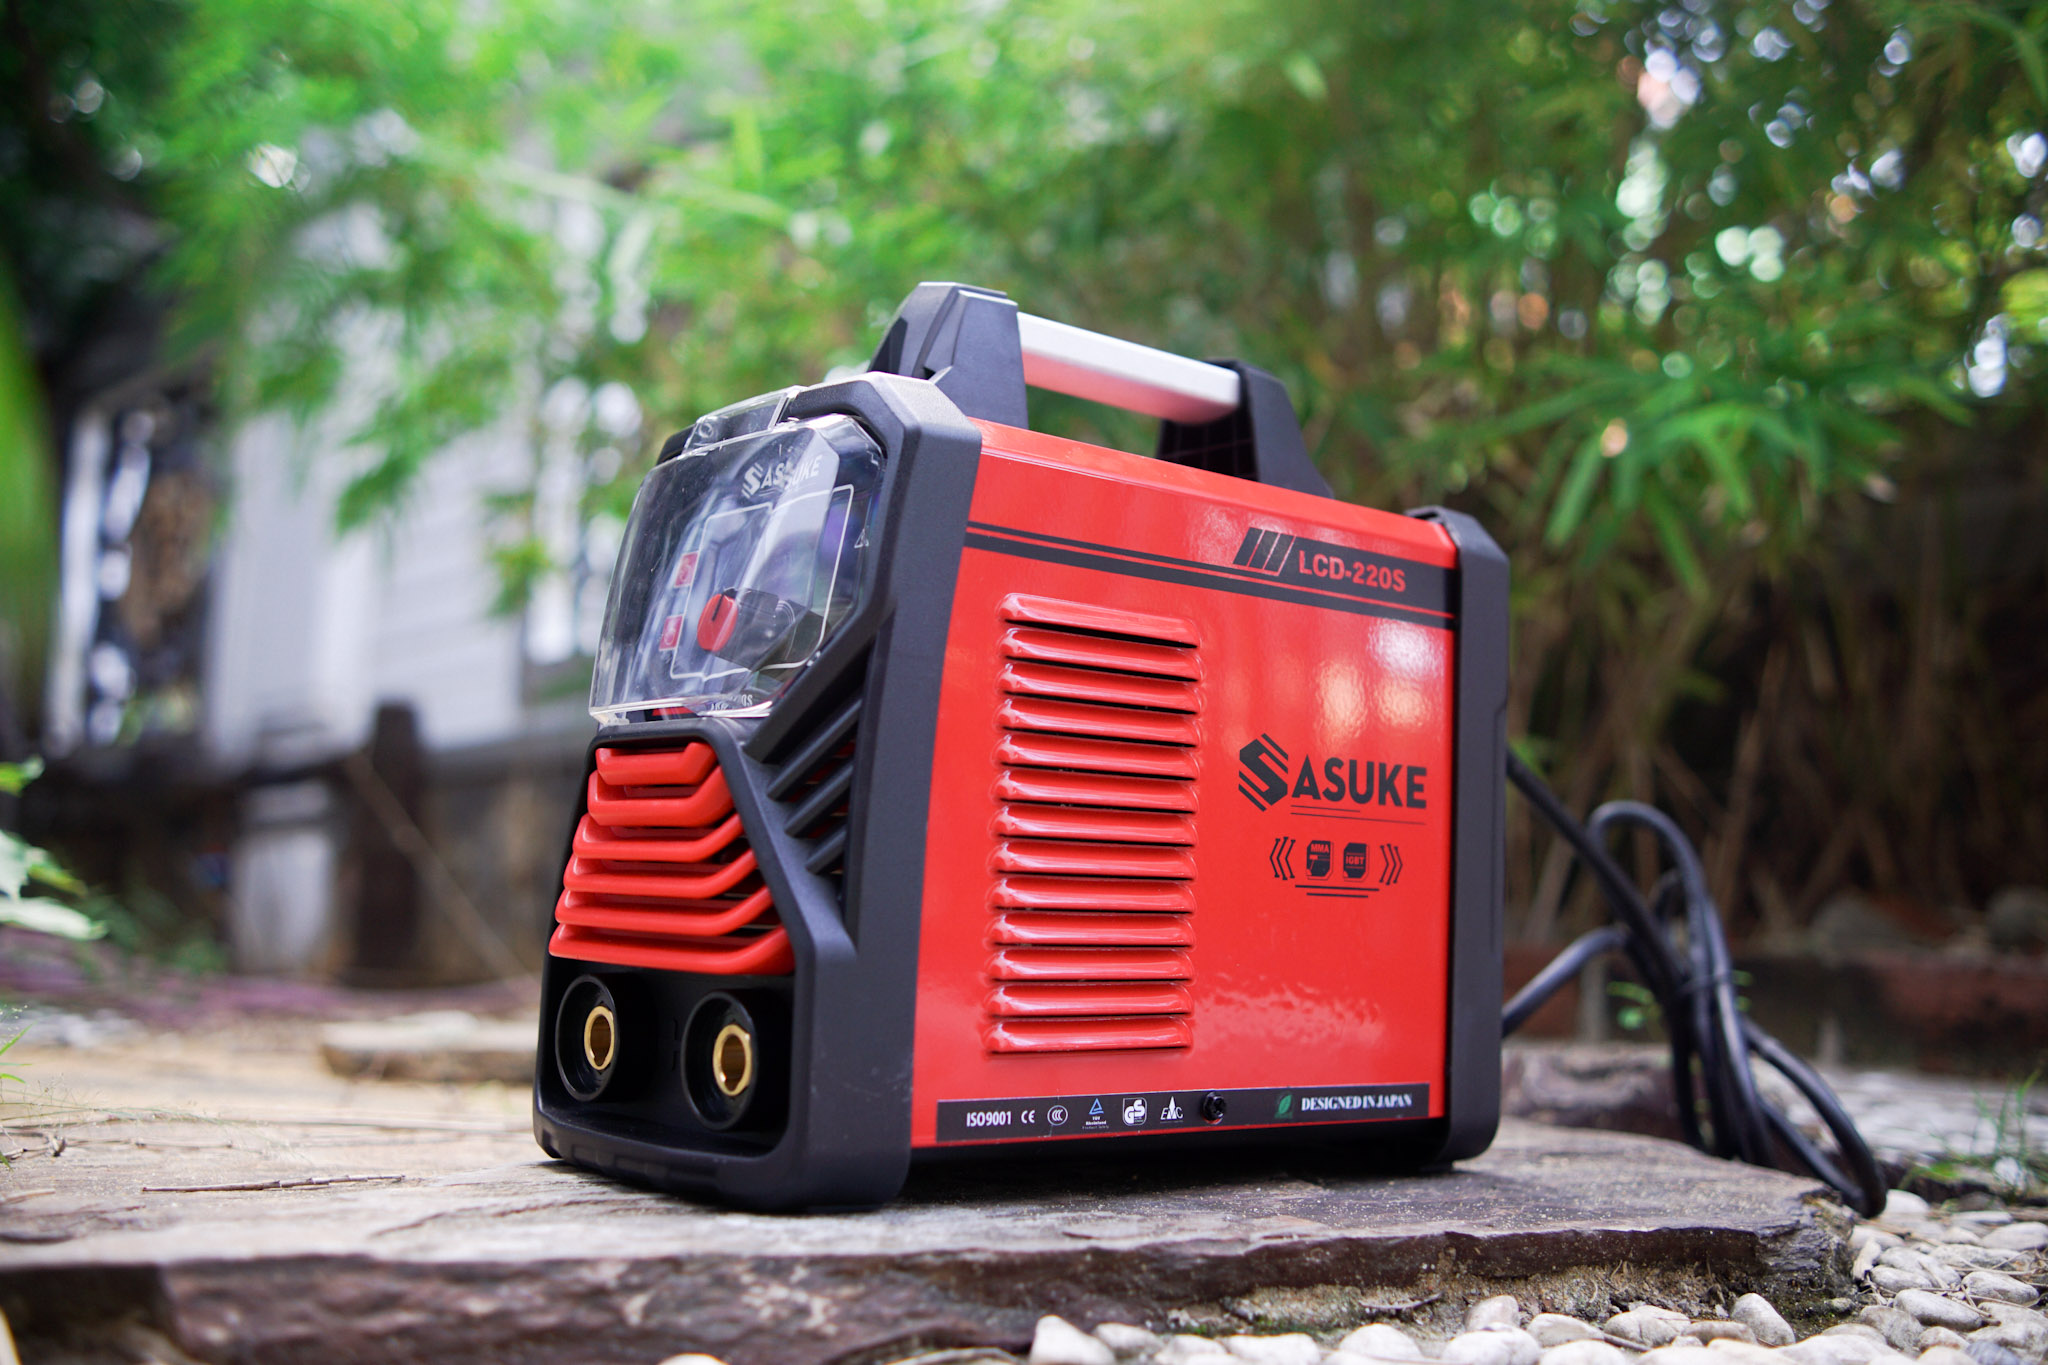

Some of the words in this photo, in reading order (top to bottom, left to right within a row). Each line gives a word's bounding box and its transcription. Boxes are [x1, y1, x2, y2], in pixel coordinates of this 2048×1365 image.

[741, 454, 822, 499] SASUKE
[1299, 550, 1406, 592] LCD-220S
[1238, 733, 1427, 812] SASUKE
[1310, 843, 1330, 854] MMA
[1345, 855, 1365, 865] IGBT
[1301, 1095, 1361, 1112] DESIGNED
[1363, 1095, 1376, 1109] IN
[1376, 1093, 1412, 1109] JAPAN
[966, 1110, 1012, 1128] ISO9001
[1021, 1109, 1036, 1124] CE
